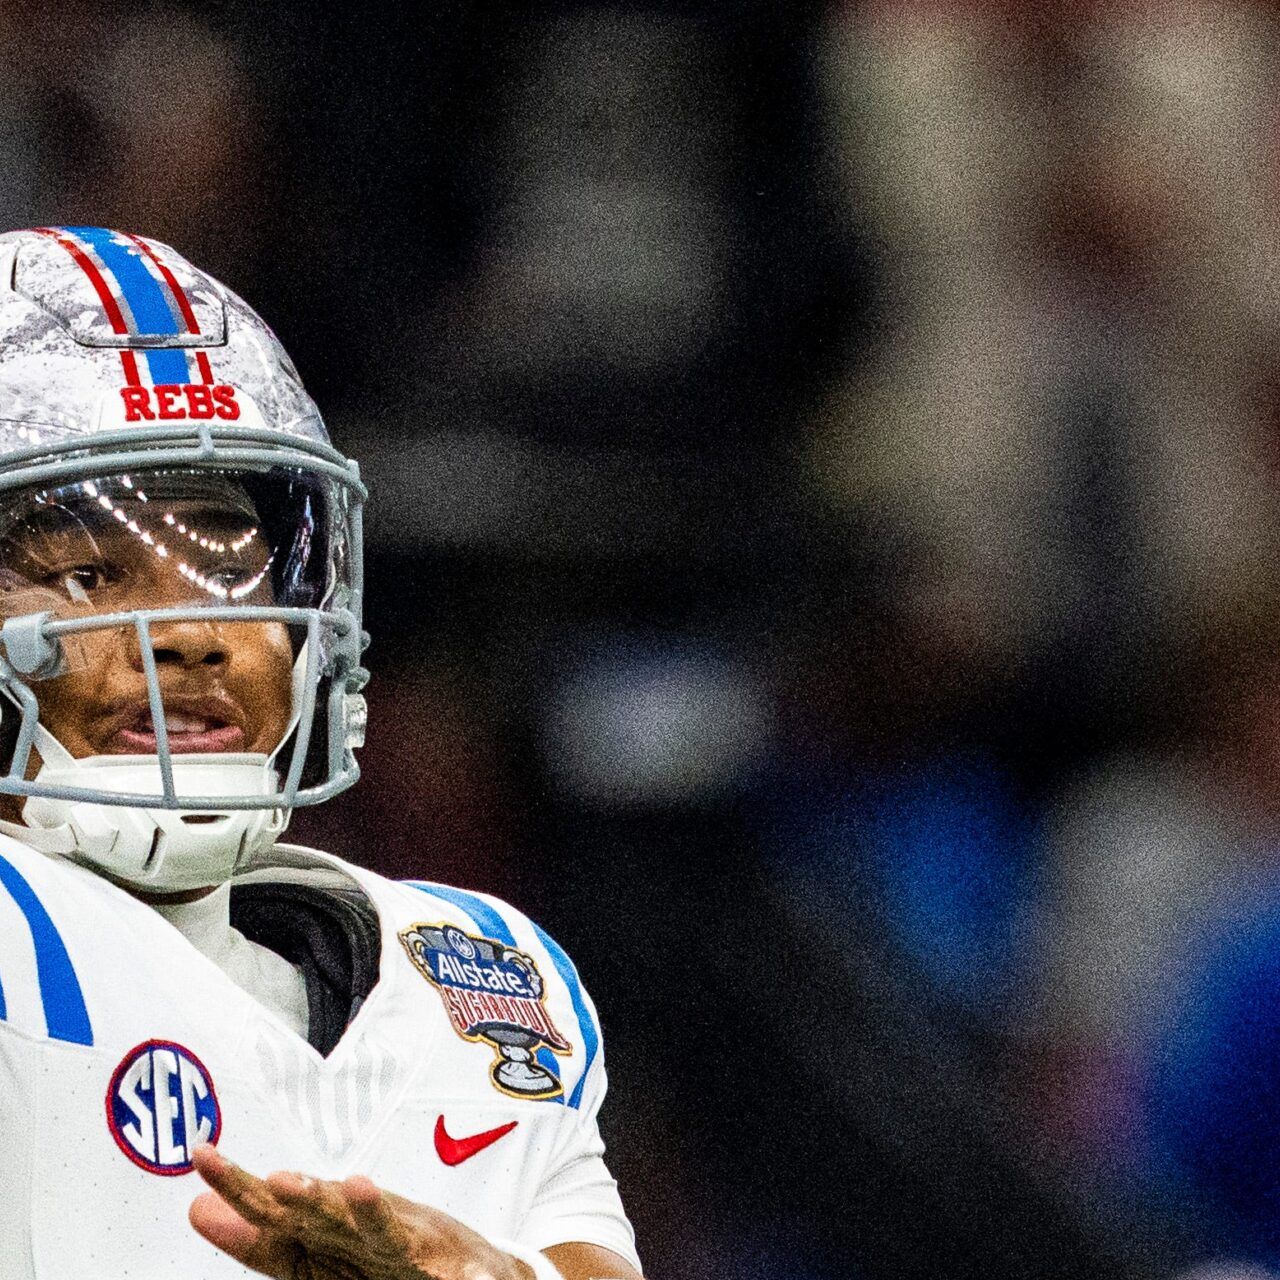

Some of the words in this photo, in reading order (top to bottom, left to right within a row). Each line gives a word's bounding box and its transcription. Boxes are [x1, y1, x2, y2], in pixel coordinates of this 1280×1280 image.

[119, 384, 241, 422] REBS
[437, 952, 527, 995] Allstate
[117, 1048, 213, 1166] SEC
